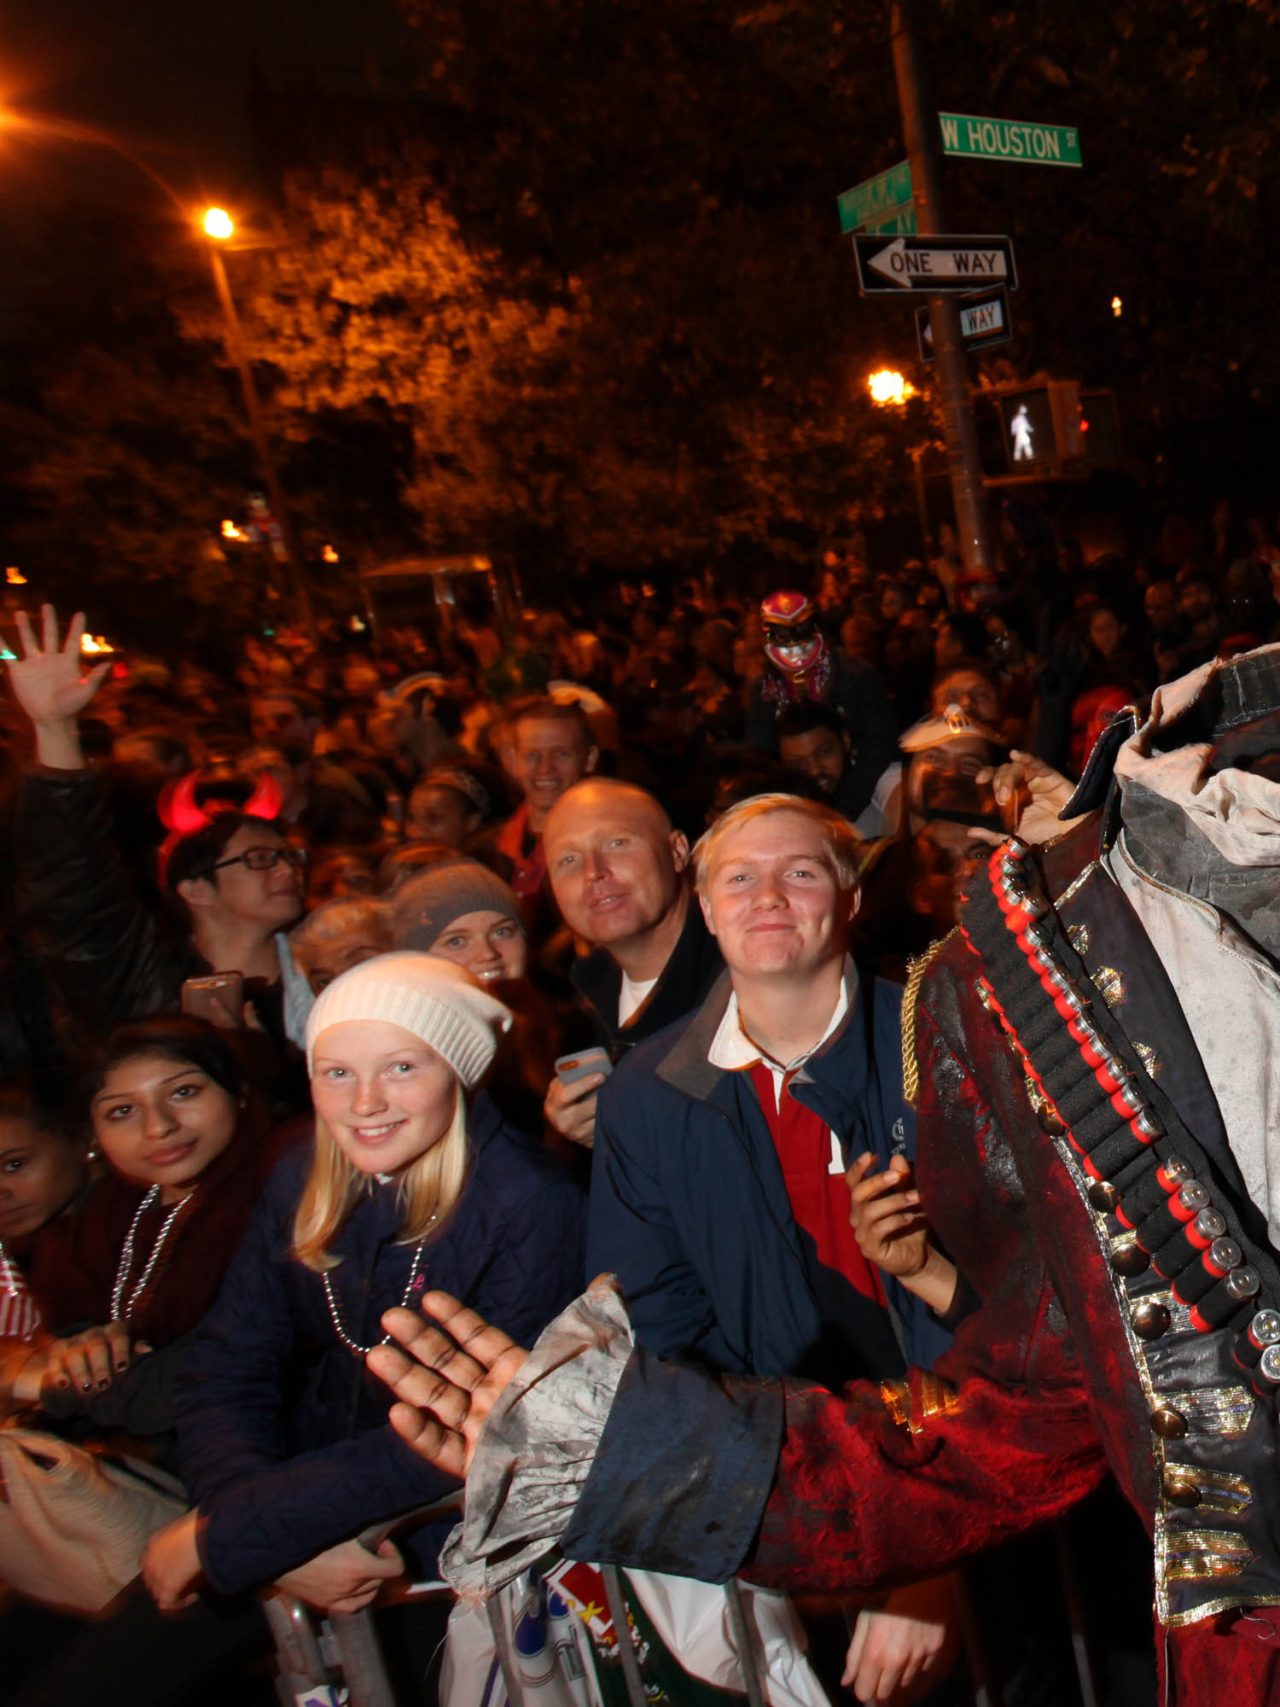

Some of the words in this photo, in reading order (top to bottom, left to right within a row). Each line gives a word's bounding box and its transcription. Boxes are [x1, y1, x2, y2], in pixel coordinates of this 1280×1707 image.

[940, 118, 959, 150] W
[967, 121, 1061, 159] HOUSTON
[1066, 131, 1077, 148] ST
[890, 252, 933, 273] ONE
[952, 252, 997, 273] WAY
[966, 305, 995, 333] WAY
